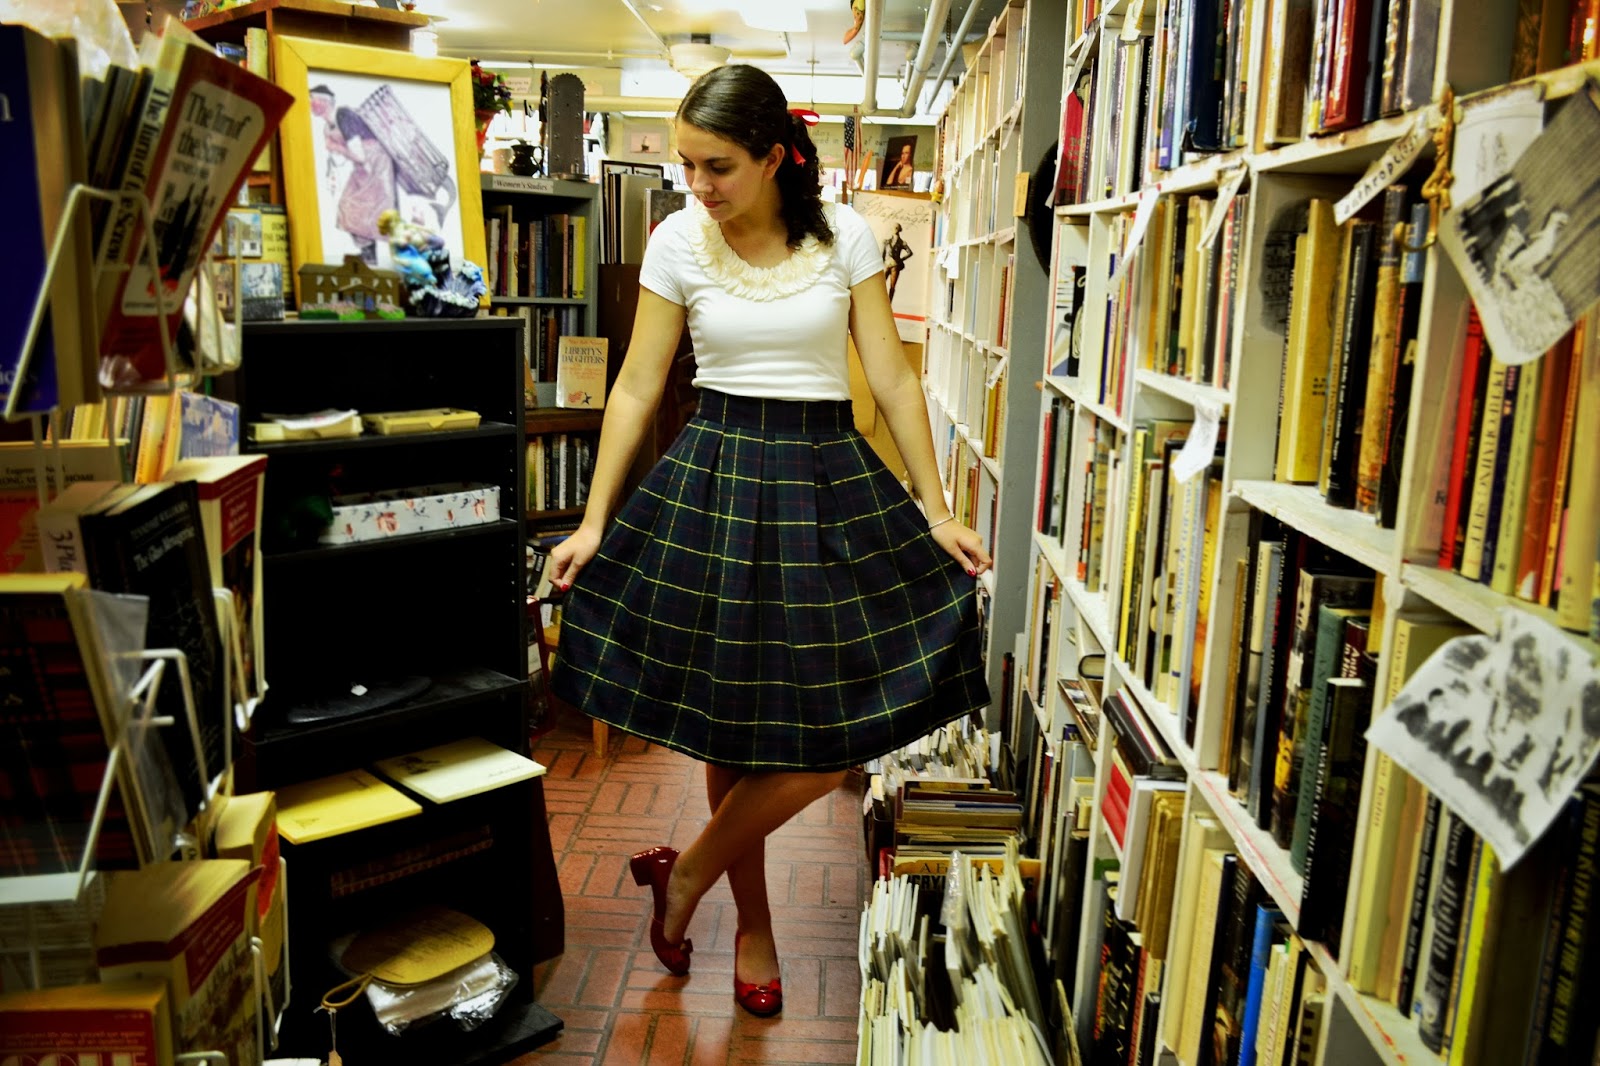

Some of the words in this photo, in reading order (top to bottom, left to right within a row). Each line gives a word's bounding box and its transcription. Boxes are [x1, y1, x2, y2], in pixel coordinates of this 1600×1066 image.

[147, 86, 169, 117] The
[185, 91, 211, 129] The
[136, 121, 159, 152] Turn
[130, 153, 147, 177] of
[121, 178, 142, 212] te
[497, 180, 526, 190] Women's
[527, 181, 548, 191] Studies
[107, 212, 135, 261] Screw
[1284, 290, 1293, 338] Practical
[562, 355, 605, 364] DAUGHTERS
[1343, 343, 1350, 351] of
[1476, 370, 1506, 490] PERFORMING
[1297, 657, 1329, 822] ANTHROPOLOGY
[1313, 741, 1328, 800] AVATARS
[1310, 802, 1321, 823] OF
[1307, 825, 1318, 851] THE
[1446, 818, 1464, 866] Street
[1301, 854, 1314, 899] WORD
